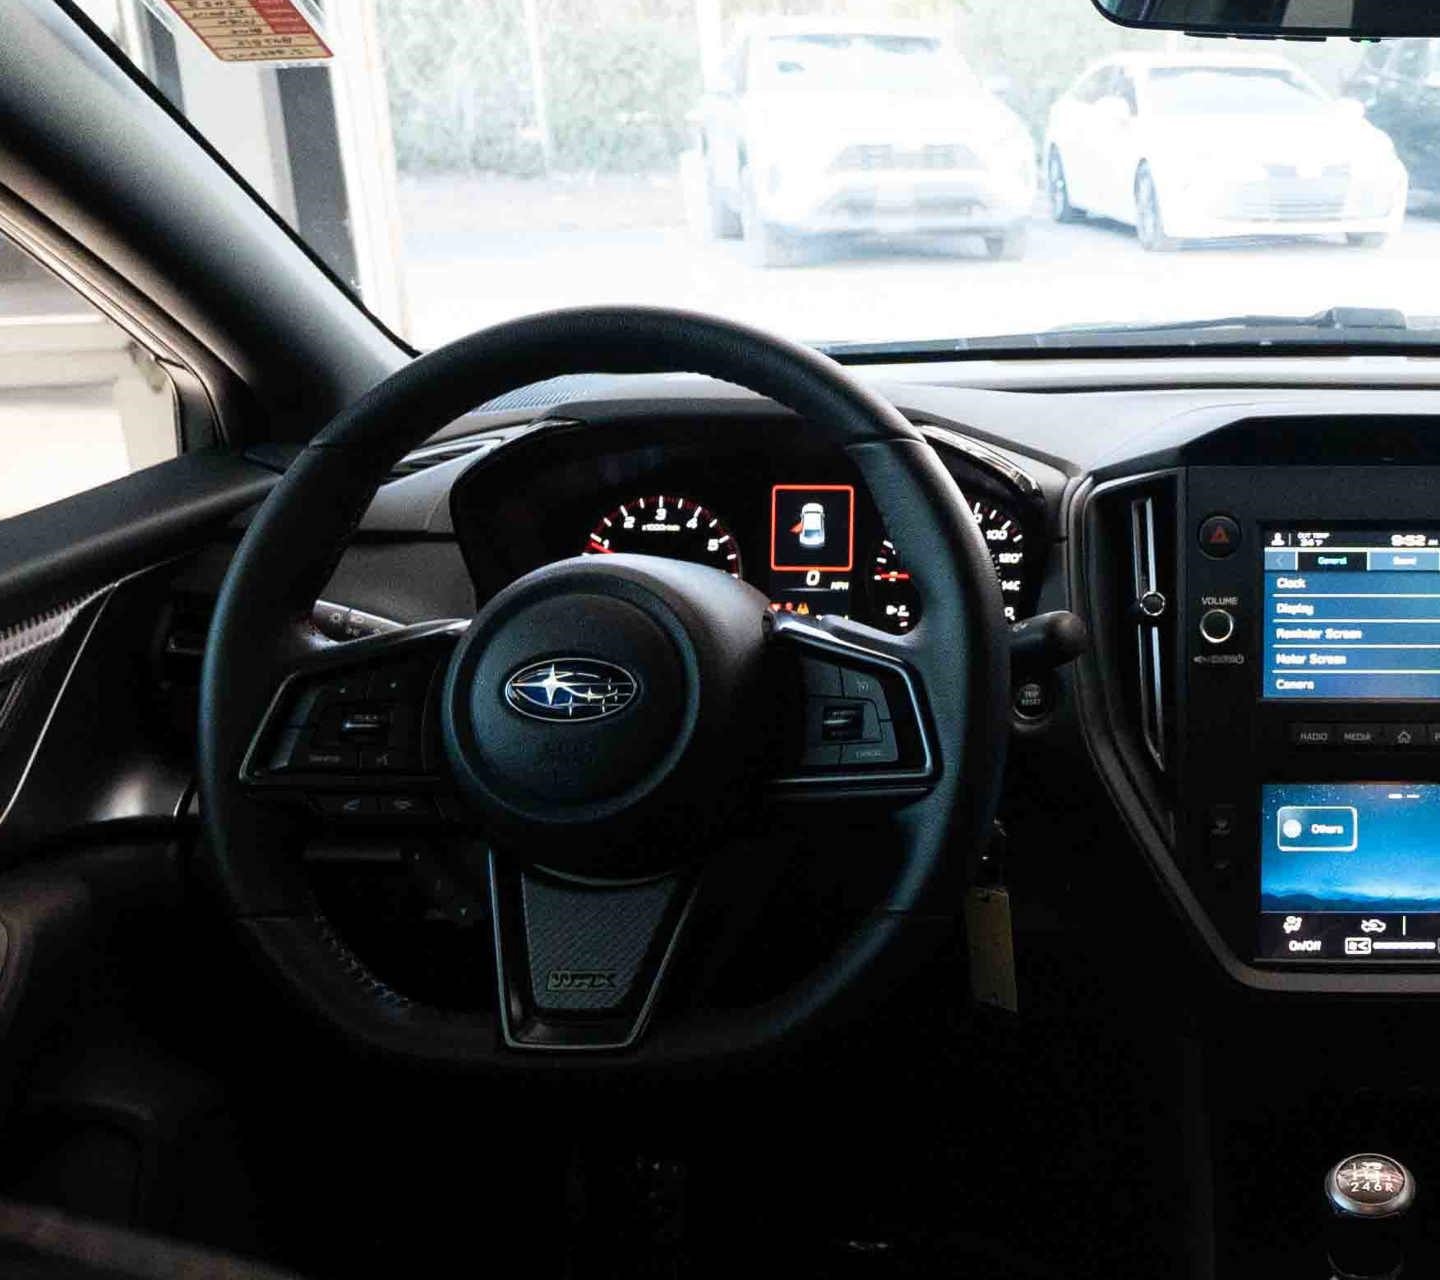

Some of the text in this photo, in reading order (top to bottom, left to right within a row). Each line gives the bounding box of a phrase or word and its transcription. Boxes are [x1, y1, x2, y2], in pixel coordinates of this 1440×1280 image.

[655, 508, 667, 521] 3
[623, 516, 635, 529] 2
[686, 517, 698, 529] 4
[986, 529, 1008, 540] 100
[707, 538, 719, 551] 5
[806, 570, 820, 586] 0
[1201, 596, 1238, 605] VOLUME
[1350, 1182, 1394, 1192] 2 4 6 R
